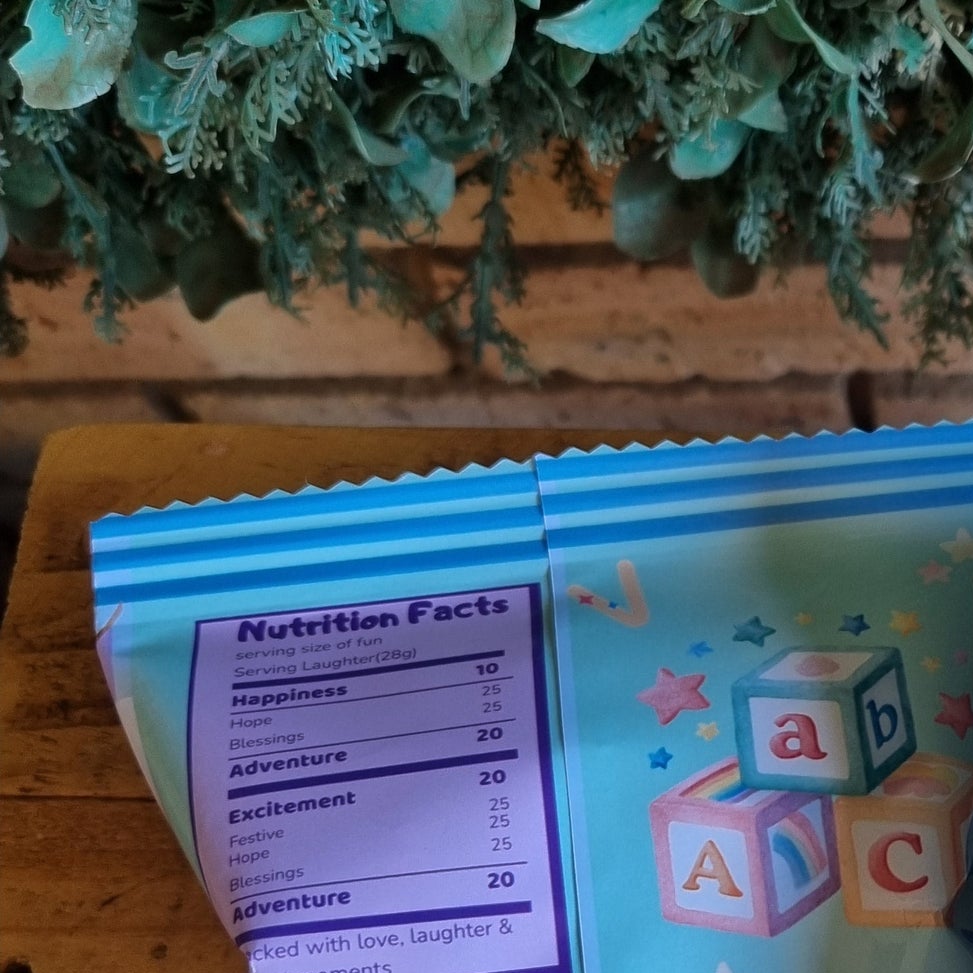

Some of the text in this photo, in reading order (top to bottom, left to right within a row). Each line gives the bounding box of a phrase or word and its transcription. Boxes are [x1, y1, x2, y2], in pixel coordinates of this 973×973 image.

[237, 596, 509, 643] Nutrition Facts
[233, 647, 417, 679] Serving Laughter(28g)
[235, 635, 383, 662] serving size of fun
[230, 684, 501, 731] Hope 25
[232, 662, 499, 708] Happiness 10
[229, 701, 502, 750] Blessings 25
[769, 713, 828, 760] a
[866, 699, 898, 747] b
[229, 727, 503, 779] Adventure 20
[228, 769, 506, 825] Excitement 20
[228, 815, 510, 867] Hope 25
[229, 798, 510, 848] Festive 25
[230, 837, 513, 893] Blessings 25
[682, 840, 743, 898] A
[233, 871, 515, 924] Adventure 20
[306, 935, 351, 955] with
[357, 932, 404, 951] love,
[410, 921, 492, 949] laughter
[499, 918, 513, 934] &
